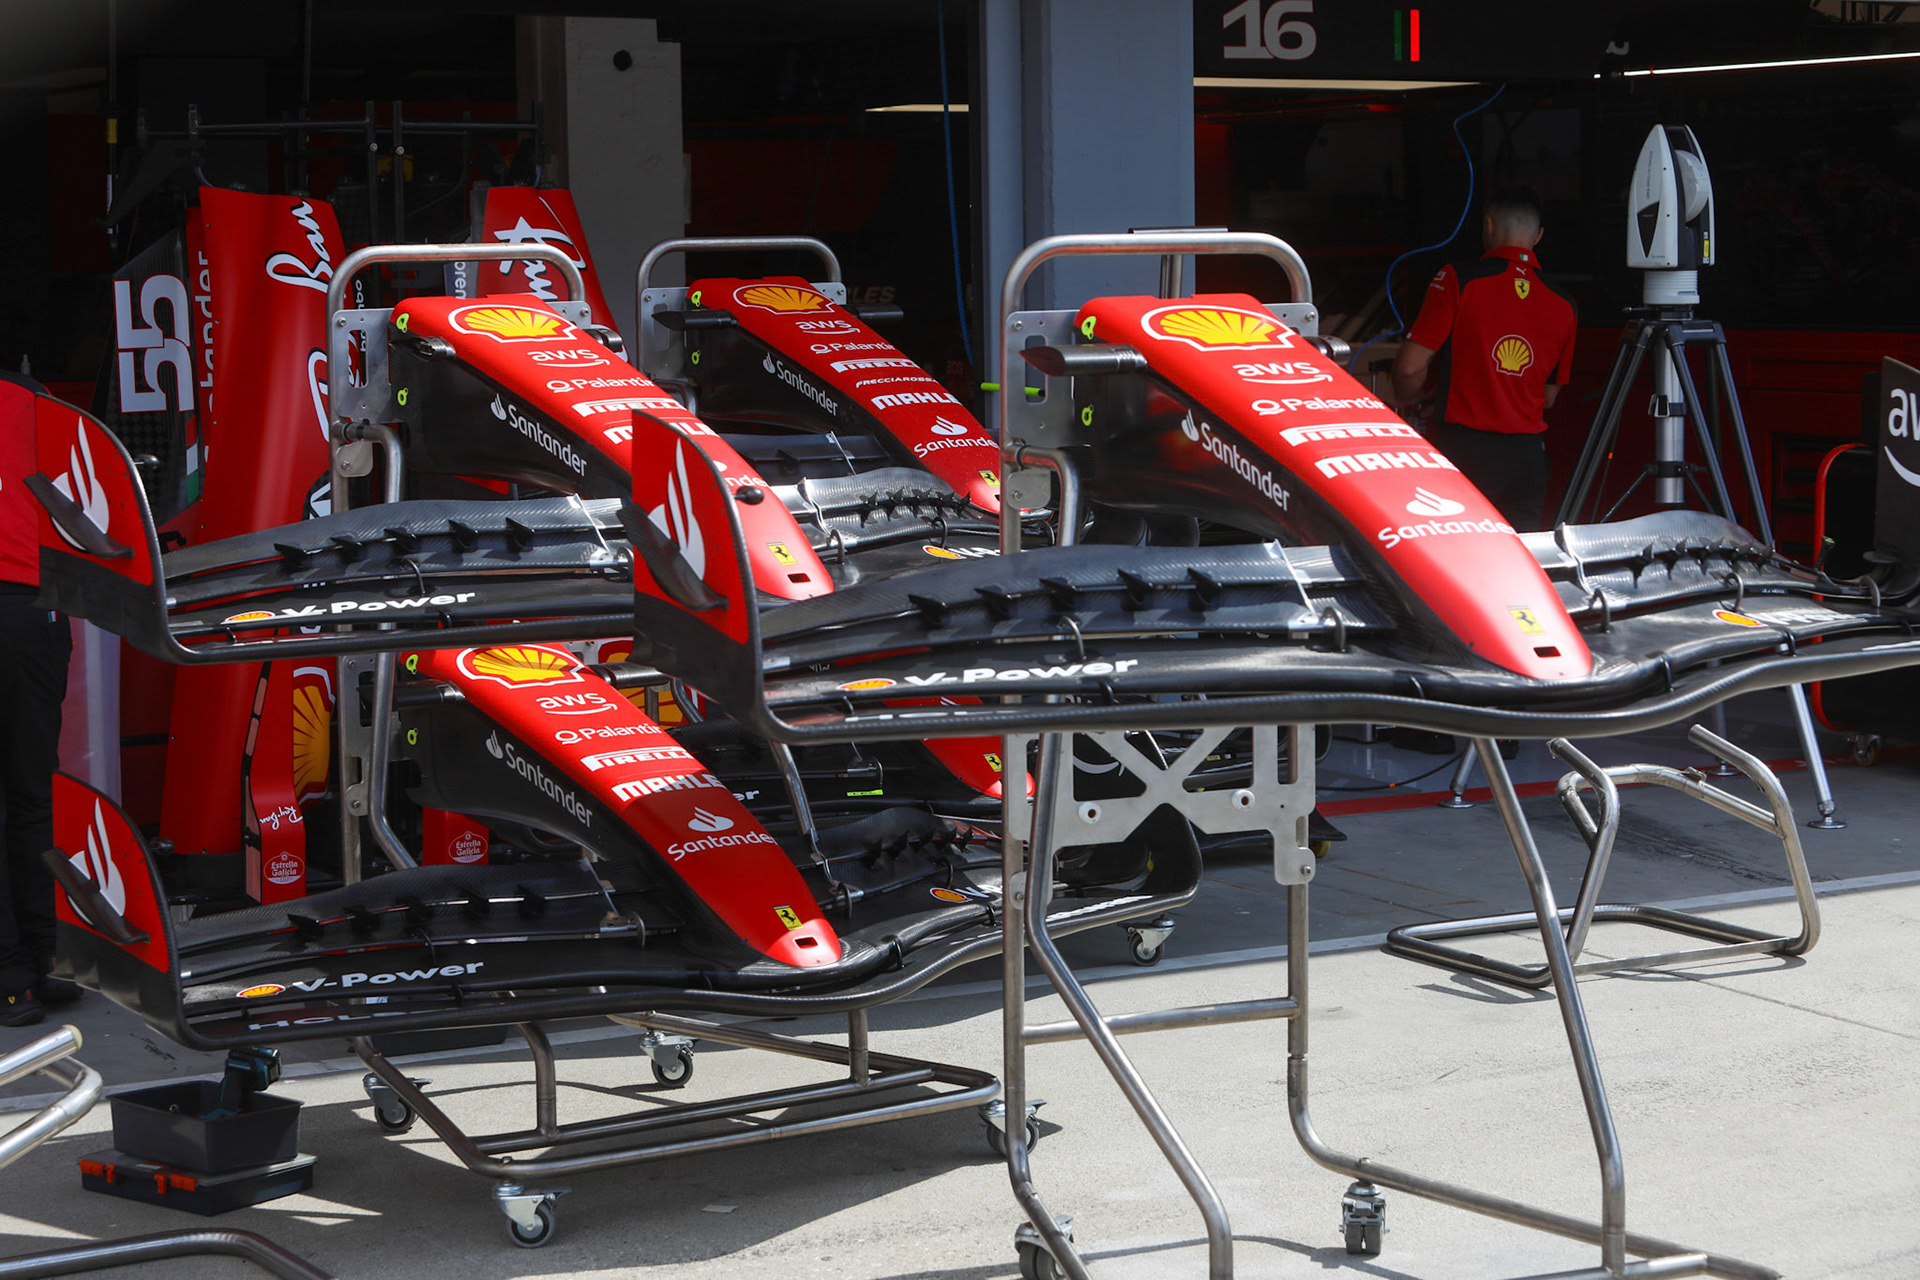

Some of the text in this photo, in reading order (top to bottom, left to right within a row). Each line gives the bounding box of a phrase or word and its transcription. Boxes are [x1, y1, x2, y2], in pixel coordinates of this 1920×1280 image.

[1222, 0, 1317, 60] 16
[795, 320, 852, 330] aws
[114, 274, 195, 413] 55
[829, 342, 895, 352] Palantir
[527, 348, 600, 361] aws
[1232, 362, 1321, 376] aws
[571, 377, 655, 390] Palantir
[775, 360, 838, 418] Santander
[1281, 397, 1386, 412] Palantir
[507, 403, 588, 477] Santander
[914, 437, 1000, 458] Santande
[1200, 422, 1290, 511] Santander
[1378, 519, 1519, 549] Santande
[281, 590, 476, 618] V-Power
[904, 658, 1138, 686] V-Power
[535, 692, 606, 709] aws
[578, 723, 662, 740] Palantir
[505, 742, 593, 828] Santander
[611, 774, 728, 802] MAHLE
[456, 840, 481, 849] Estrella
[456, 848, 480, 856] Galicia
[271, 861, 298, 869] Estrella
[271, 868, 297, 876] Galicia
[292, 960, 484, 992] V-Power
